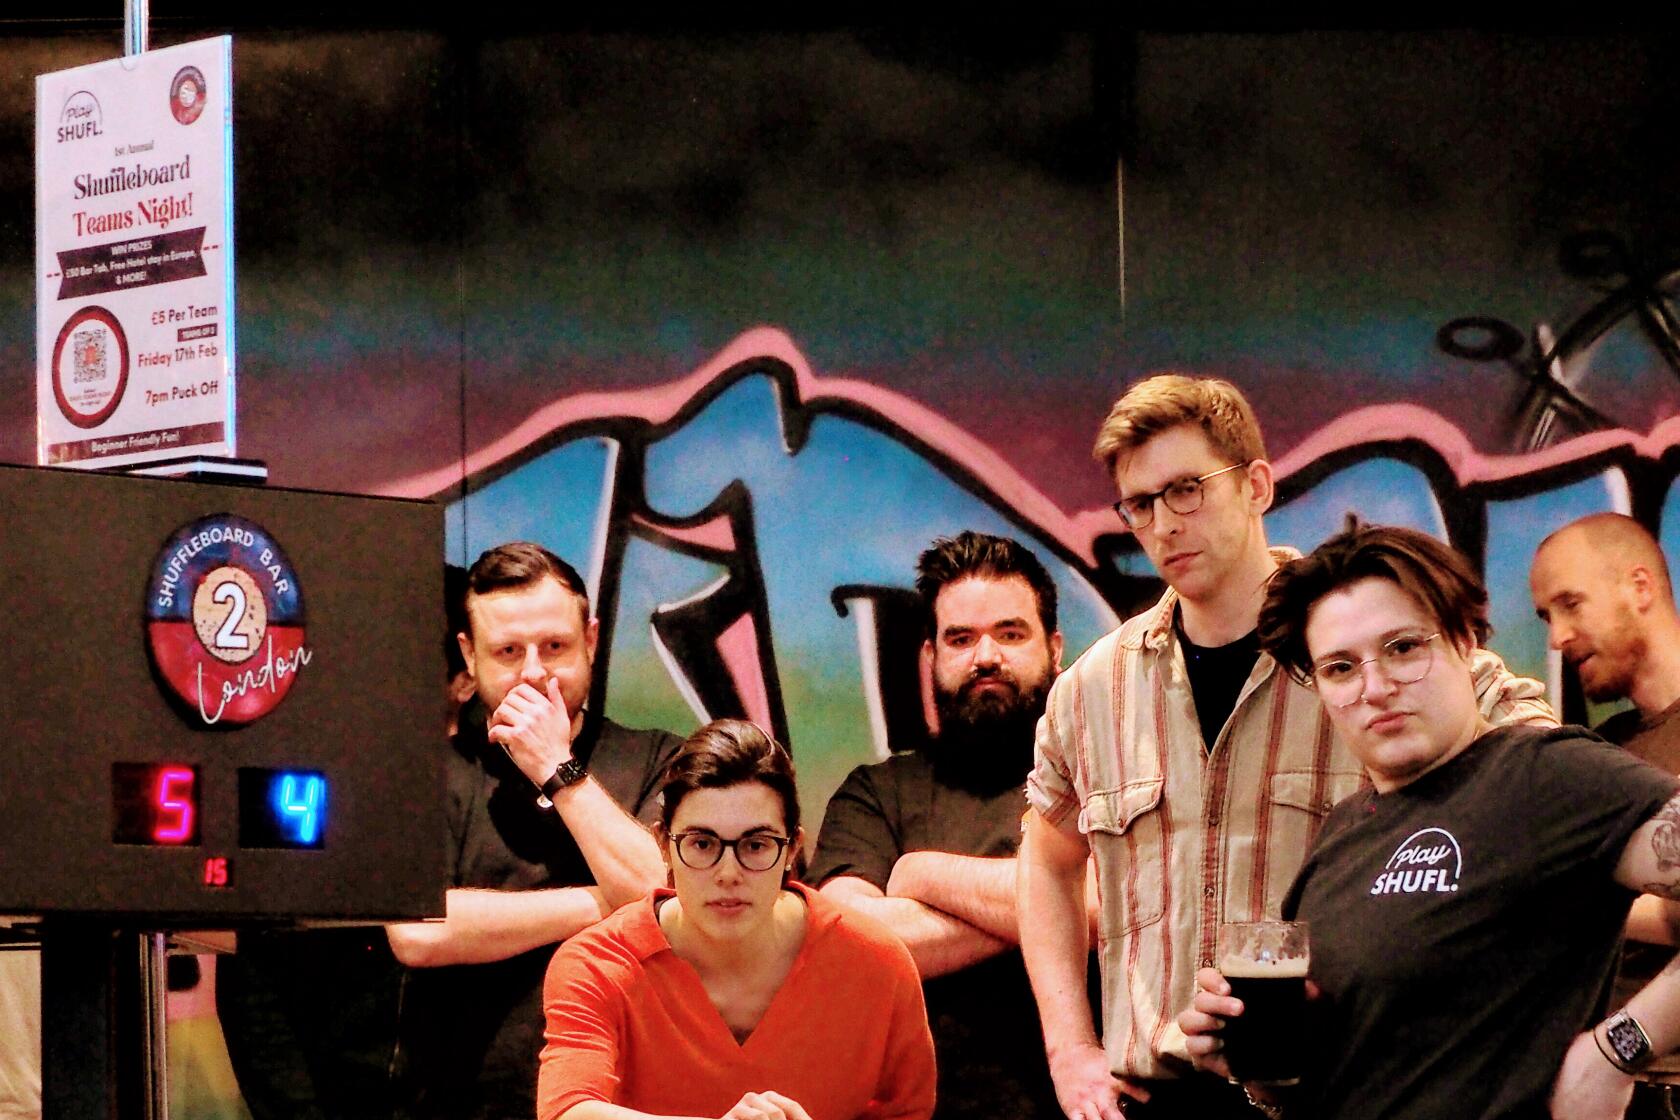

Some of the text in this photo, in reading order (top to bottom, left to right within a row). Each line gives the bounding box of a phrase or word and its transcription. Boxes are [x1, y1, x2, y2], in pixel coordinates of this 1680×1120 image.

[73, 154, 191, 200] Shuffleboard
[73, 192, 193, 237] Teams Night!
[151, 305, 218, 325] £5 Per Team
[138, 342, 218, 368] Friday 17th Feb
[145, 380, 219, 407] 7pm Puck Off
[91, 440, 128, 454] Beginner
[128, 433, 161, 448] Friendly
[158, 527, 290, 608] SHUFFLEBOARD BAR
[212, 579, 250, 650] 2
[196, 633, 313, 725] London
[154, 769, 196, 841] 5
[280, 774, 322, 844] 4
[1370, 868, 1459, 895] SHUFL.
